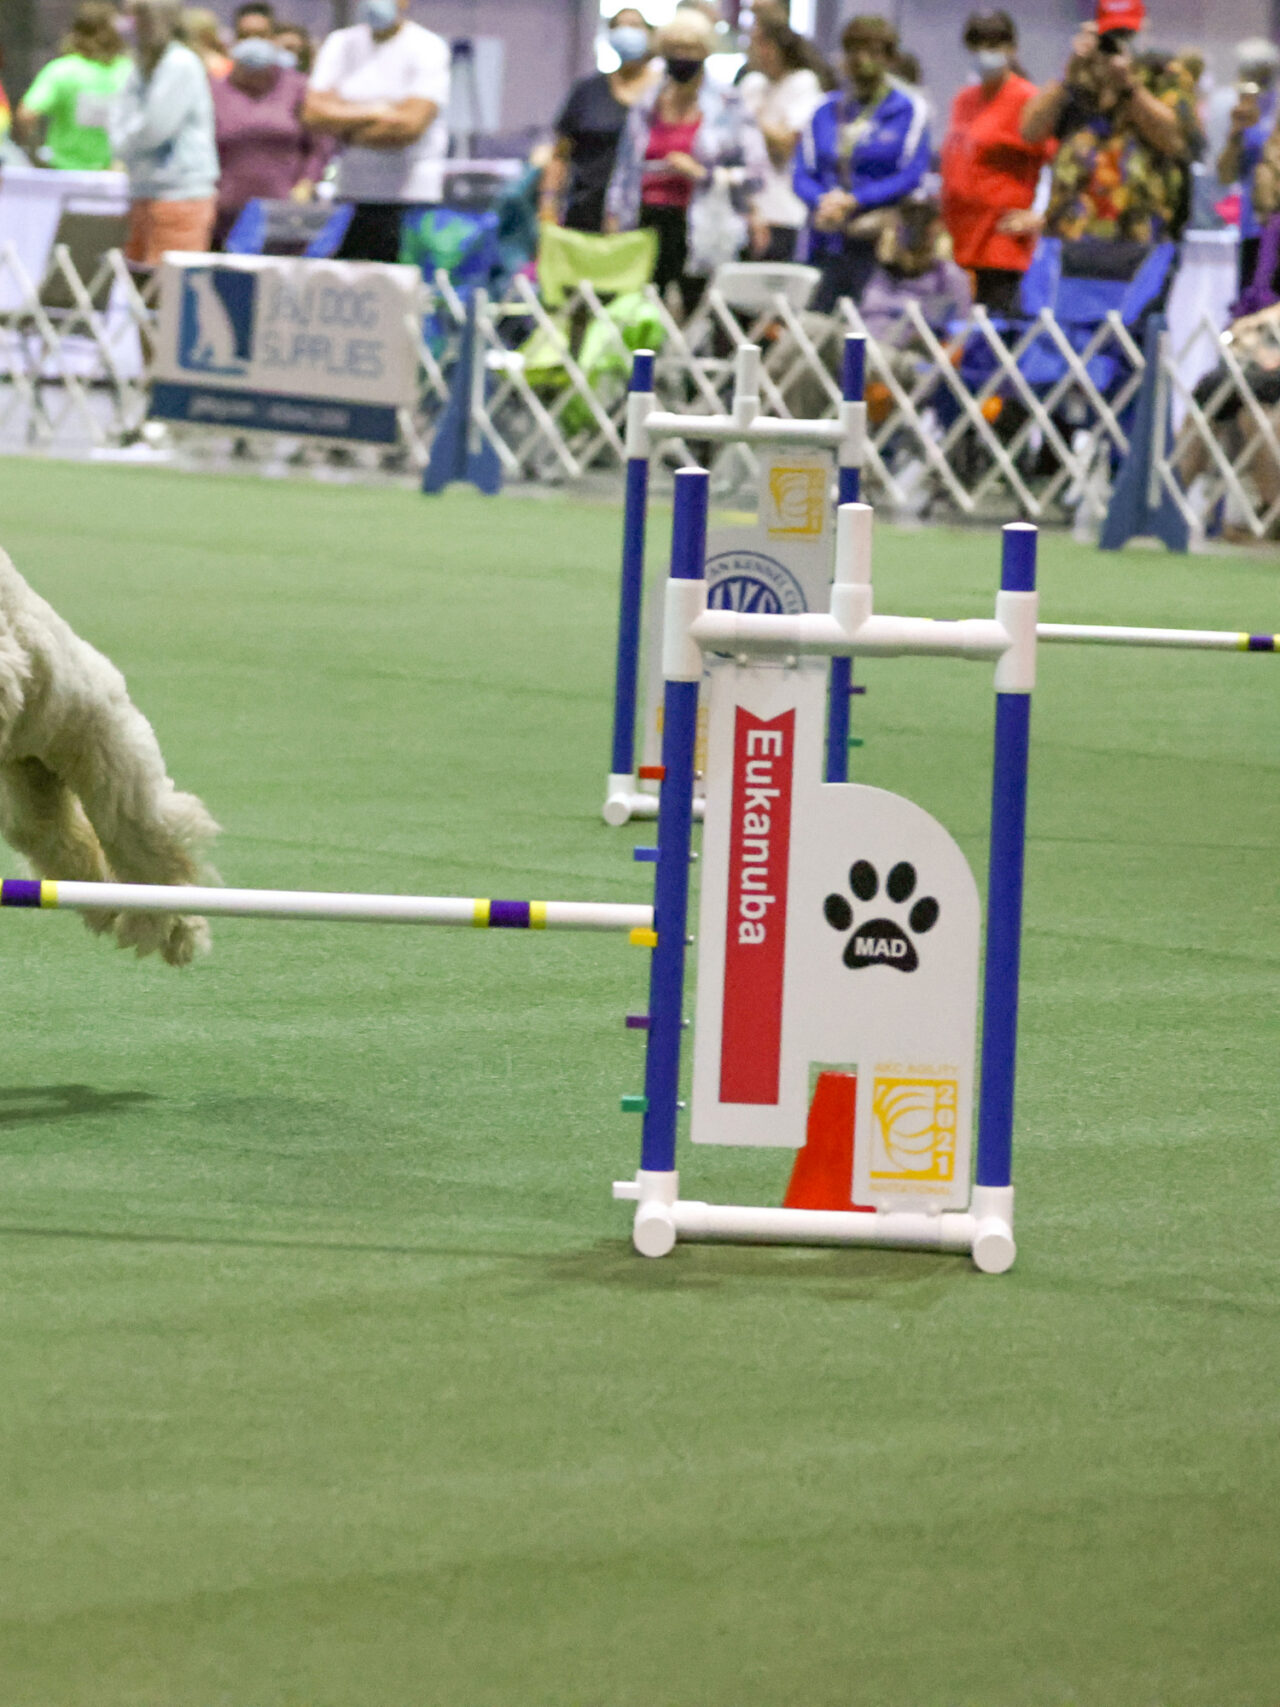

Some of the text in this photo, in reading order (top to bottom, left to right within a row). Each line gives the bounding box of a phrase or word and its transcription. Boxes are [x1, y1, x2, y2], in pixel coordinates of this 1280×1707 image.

[738, 730, 783, 945] Eukanuba
[854, 937, 908, 957] MAD
[935, 1085, 955, 1176] 2021
